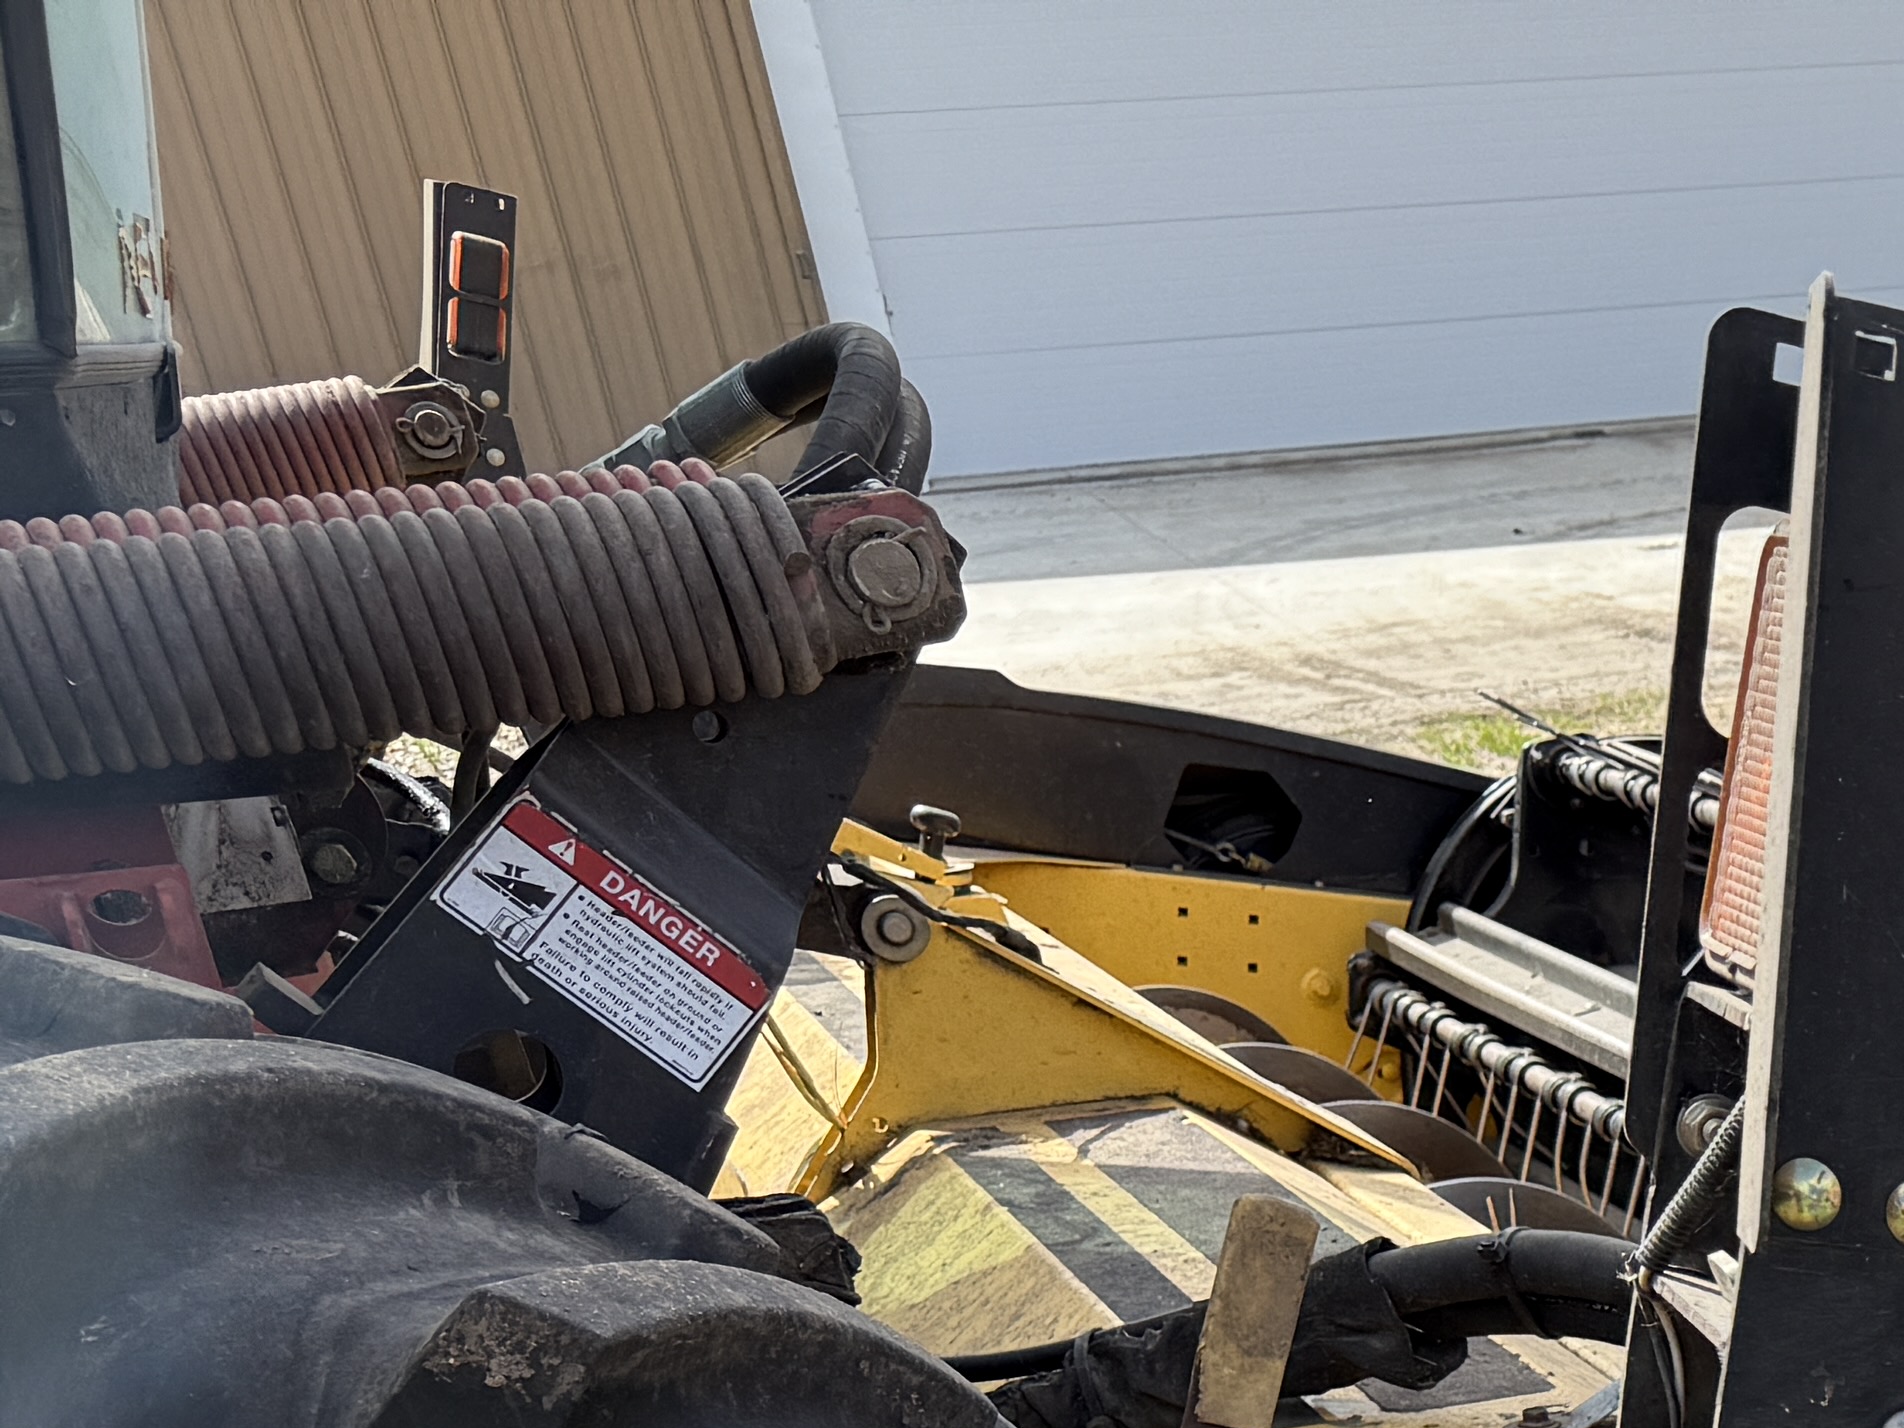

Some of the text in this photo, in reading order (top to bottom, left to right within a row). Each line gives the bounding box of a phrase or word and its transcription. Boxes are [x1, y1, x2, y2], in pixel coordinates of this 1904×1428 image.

[577, 907, 626, 947] hydraulic
[624, 942, 641, 957] lift
[638, 953, 676, 984] system
[674, 978, 709, 1007] should
[585, 898, 657, 955] Header/feeder
[673, 964, 692, 981] fall
[689, 976, 724, 1005] rapidly
[600, 869, 721, 968] DANGER
[528, 949, 564, 978] death
[577, 983, 621, 1019] serious
[618, 1013, 656, 1045] injury.
[538, 939, 701, 1061] Failure to comply will result in
[555, 934, 595, 967] working
[592, 961, 627, 989] around
[625, 984, 656, 1010] raised
[562, 927, 723, 1046] engage lift cylinder lockouts when
[593, 935, 663, 990] header/feeder
[662, 986, 677, 1000] on
[675, 996, 711, 1027] ground
